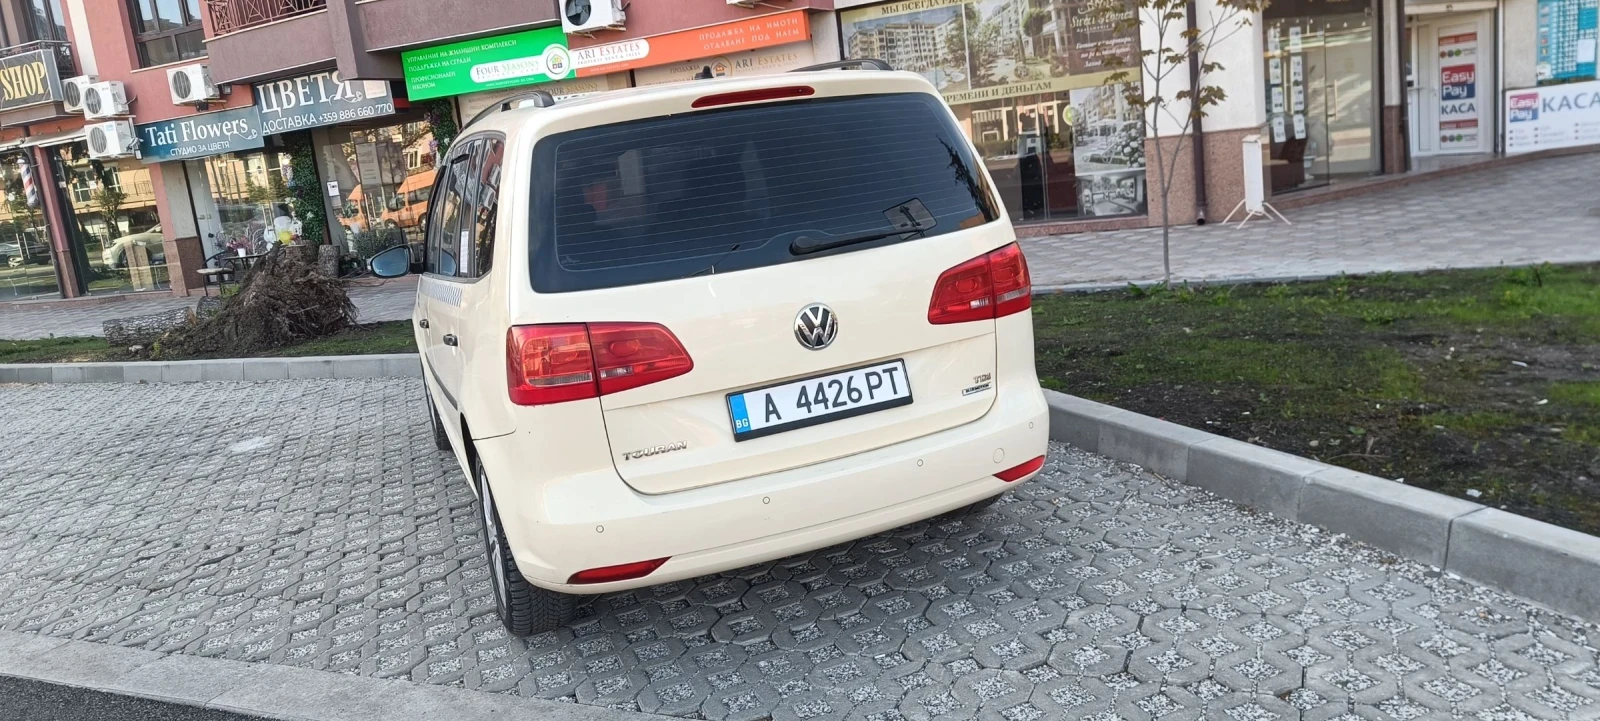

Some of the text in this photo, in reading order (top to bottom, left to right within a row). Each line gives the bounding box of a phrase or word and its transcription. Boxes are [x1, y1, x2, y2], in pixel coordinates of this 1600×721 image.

[881, 5, 899, 15] МЫ
[699, 28, 744, 41] ПРОДАЖБА
[766, 18, 798, 28] ИМОТИ
[481, 39, 517, 51] КОМПЛЕКСИ
[703, 28, 800, 50] ОТДАВАНЕ ПОД НАЕМ
[577, 42, 640, 60] ARI ESTATES
[476, 60, 539, 76] FOUR SEASONS
[735, 58, 753, 70] ARI
[758, 52, 798, 66] ESTATES
[0, 61, 46, 101] SHOP
[1442, 69, 1475, 84] Easy
[256, 70, 355, 118] ЦВЕТЯ
[991, 88, 999, 97] И
[1001, 81, 1052, 96] ДЕНЬГАМ
[1443, 84, 1467, 98] Pay
[1441, 102, 1476, 115] КАСА
[1510, 97, 1539, 109] Easy
[1542, 92, 1600, 113] КАСА
[261, 102, 393, 135] ДОСТАВКА +359 886 660 770
[1510, 109, 1533, 121] Pay
[145, 117, 249, 147] Tati Flowers
[170, 140, 230, 157] СТУДИО ЗА ЦВЕТЯ
[764, 366, 899, 423] A 4426 PT
[735, 418, 749, 429] BG
[622, 440, 687, 461] TOURAN
